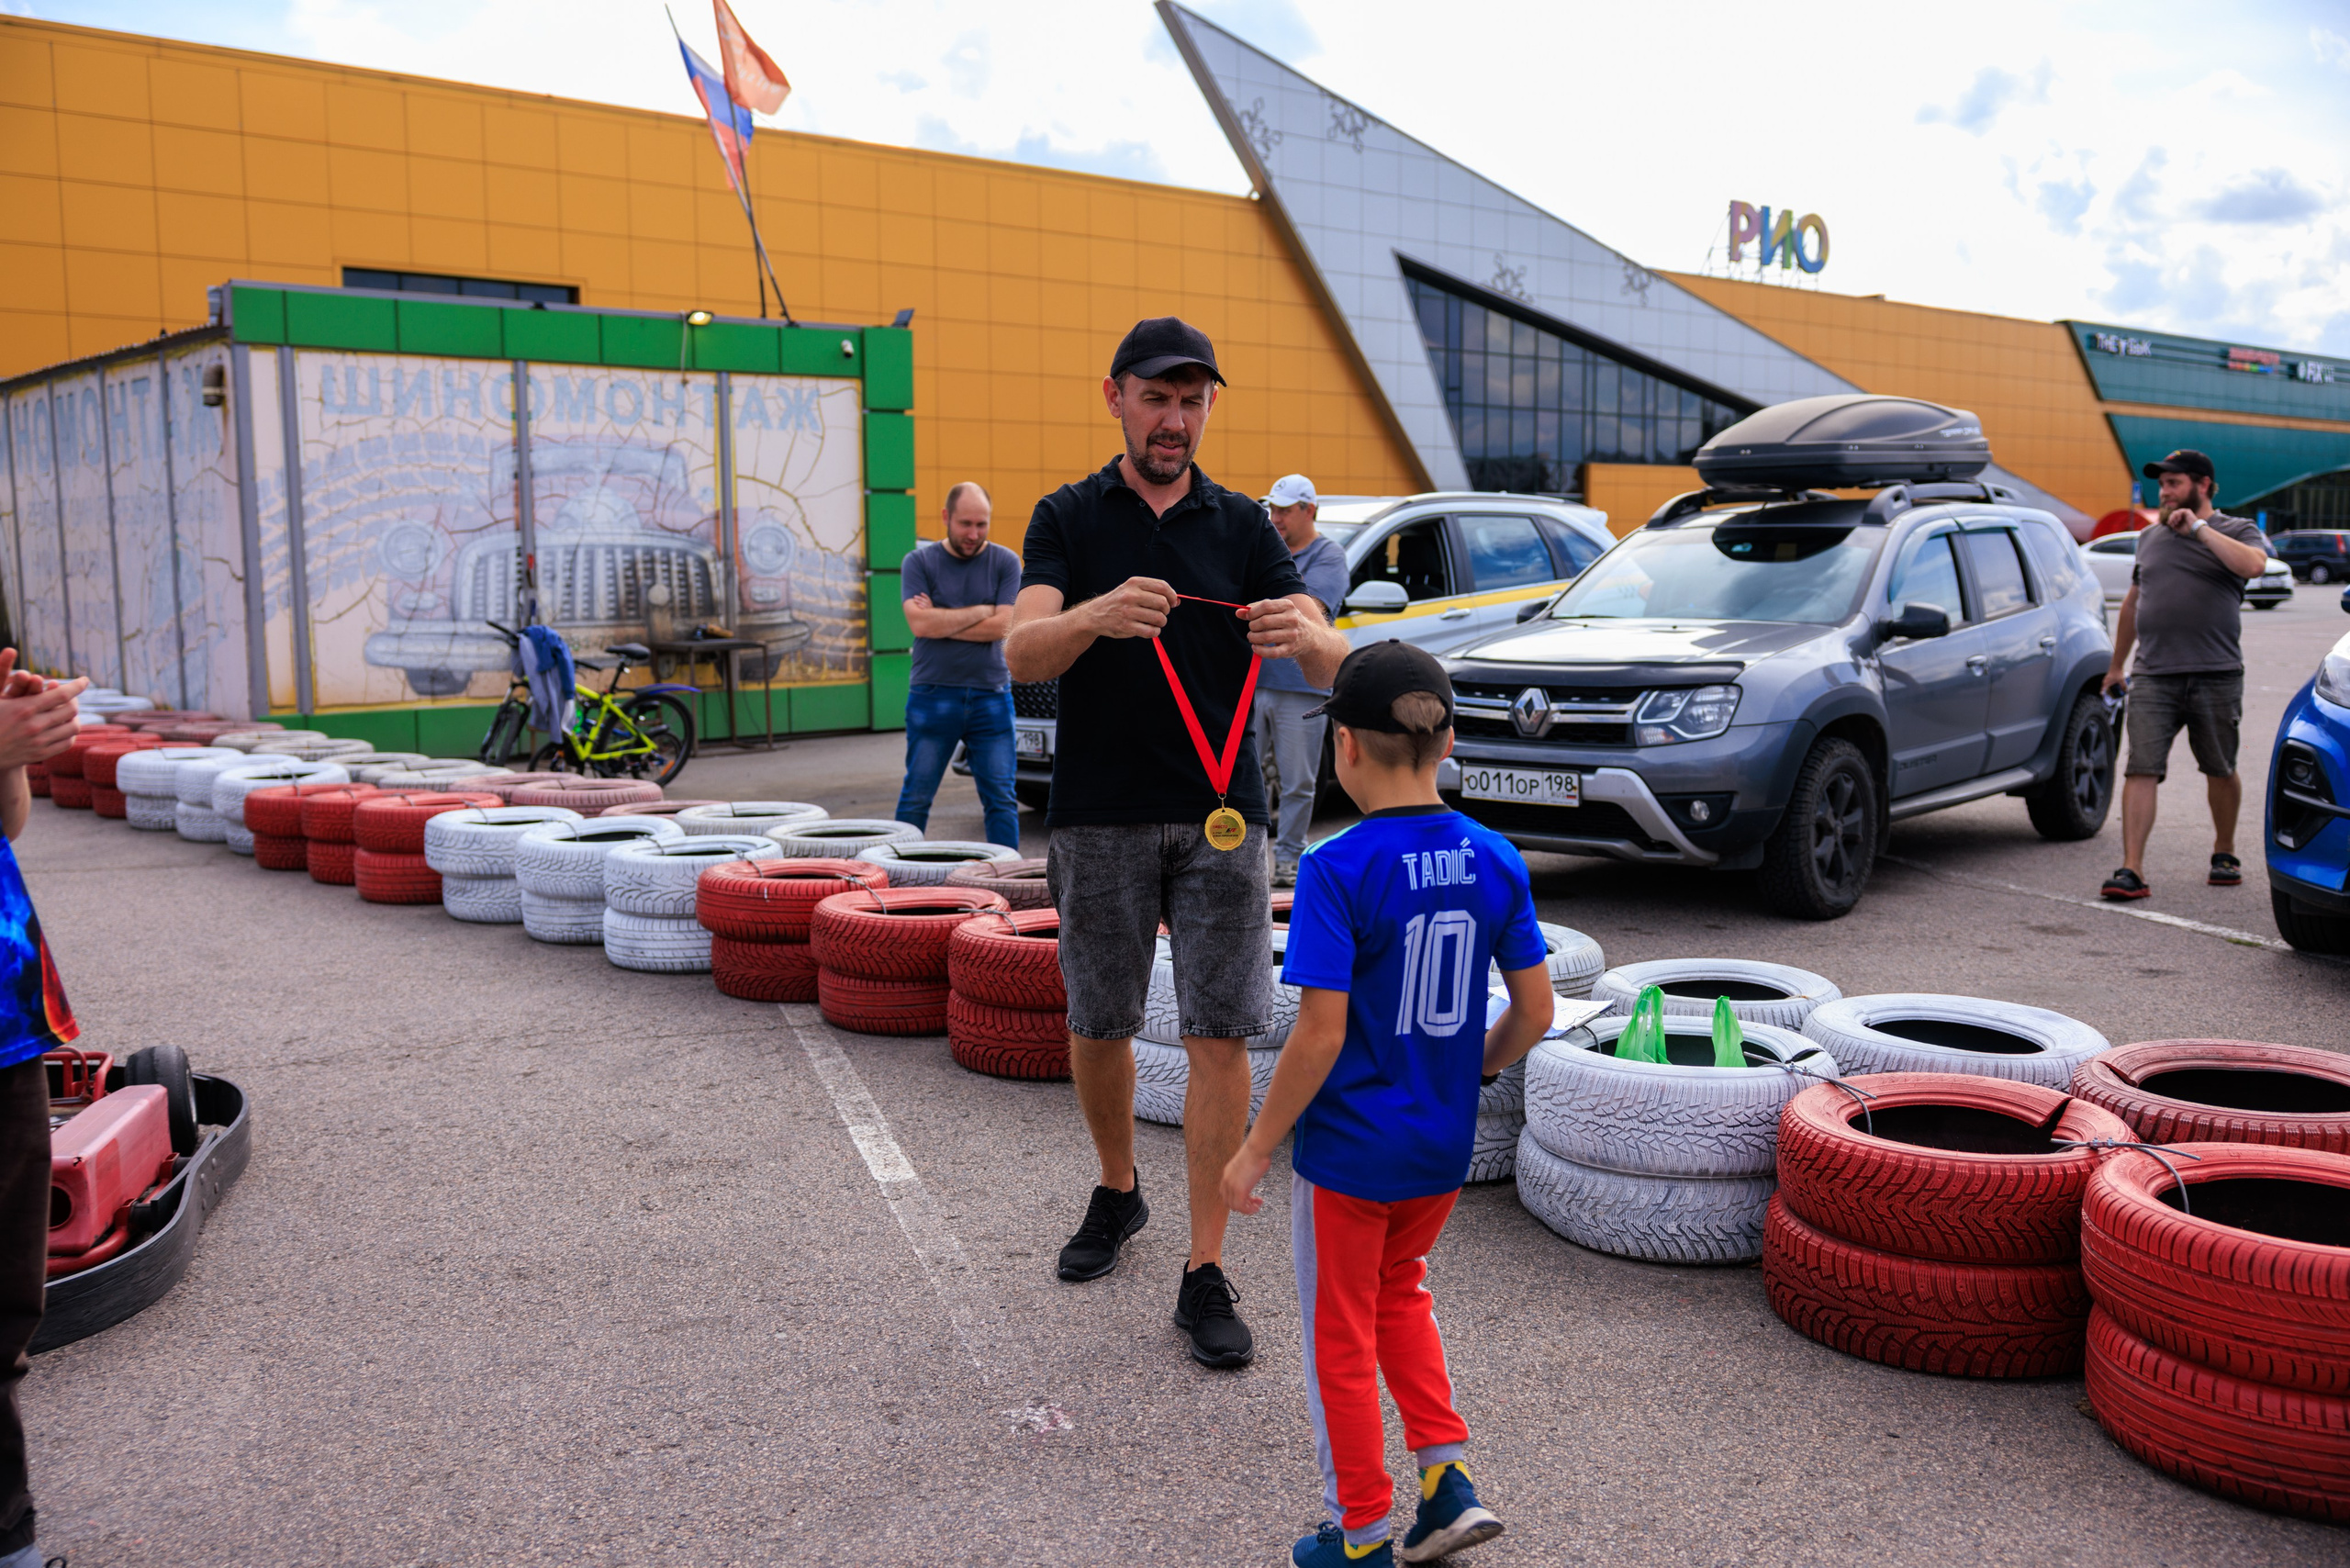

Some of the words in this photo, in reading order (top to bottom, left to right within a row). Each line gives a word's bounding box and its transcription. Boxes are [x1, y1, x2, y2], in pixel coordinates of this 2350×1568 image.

[1729, 199, 1830, 274] РИО
[320, 364, 821, 431] ШИНОМОНТАЖ
[1545, 774, 1573, 792] 198
[1402, 836, 1477, 891] TADIĆ
[1395, 909, 1477, 1037] 10
